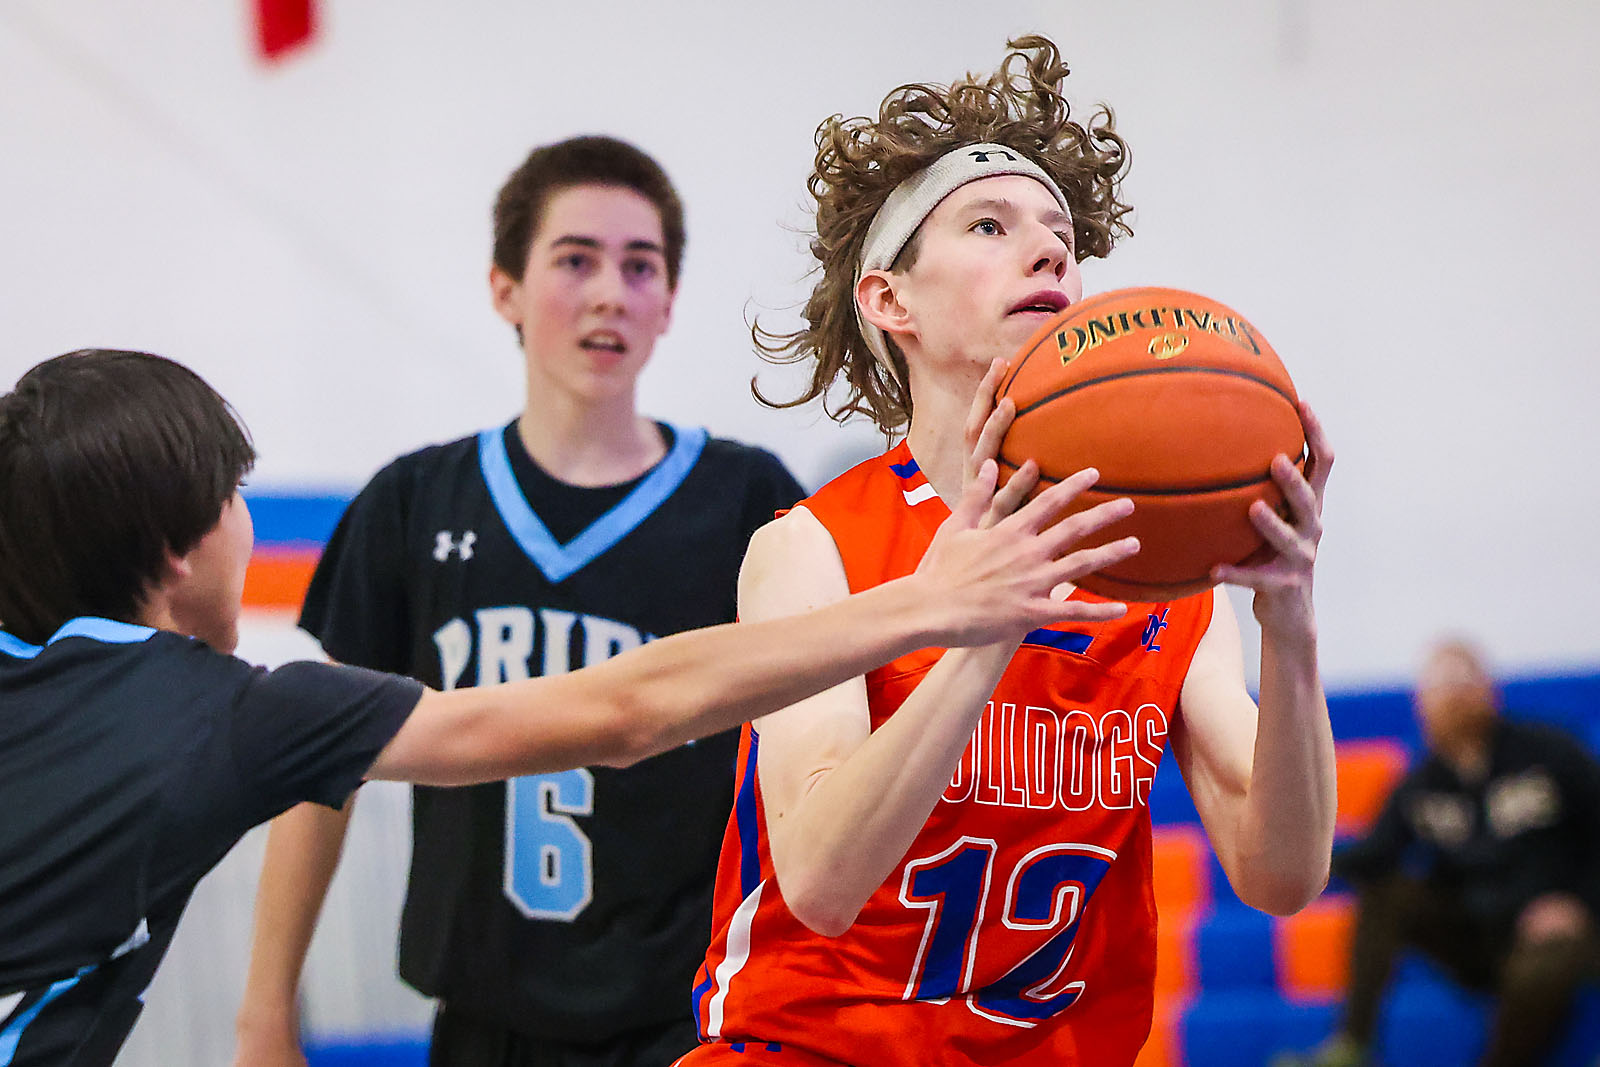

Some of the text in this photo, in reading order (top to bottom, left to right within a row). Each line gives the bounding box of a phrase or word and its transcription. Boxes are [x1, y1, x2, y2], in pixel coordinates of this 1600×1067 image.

[1055, 307, 1262, 367] SPALDING
[432, 605, 660, 691] PRI
[941, 701, 1168, 811] LLDOGS
[503, 767, 595, 923] 6
[898, 835, 1118, 1029] 12
